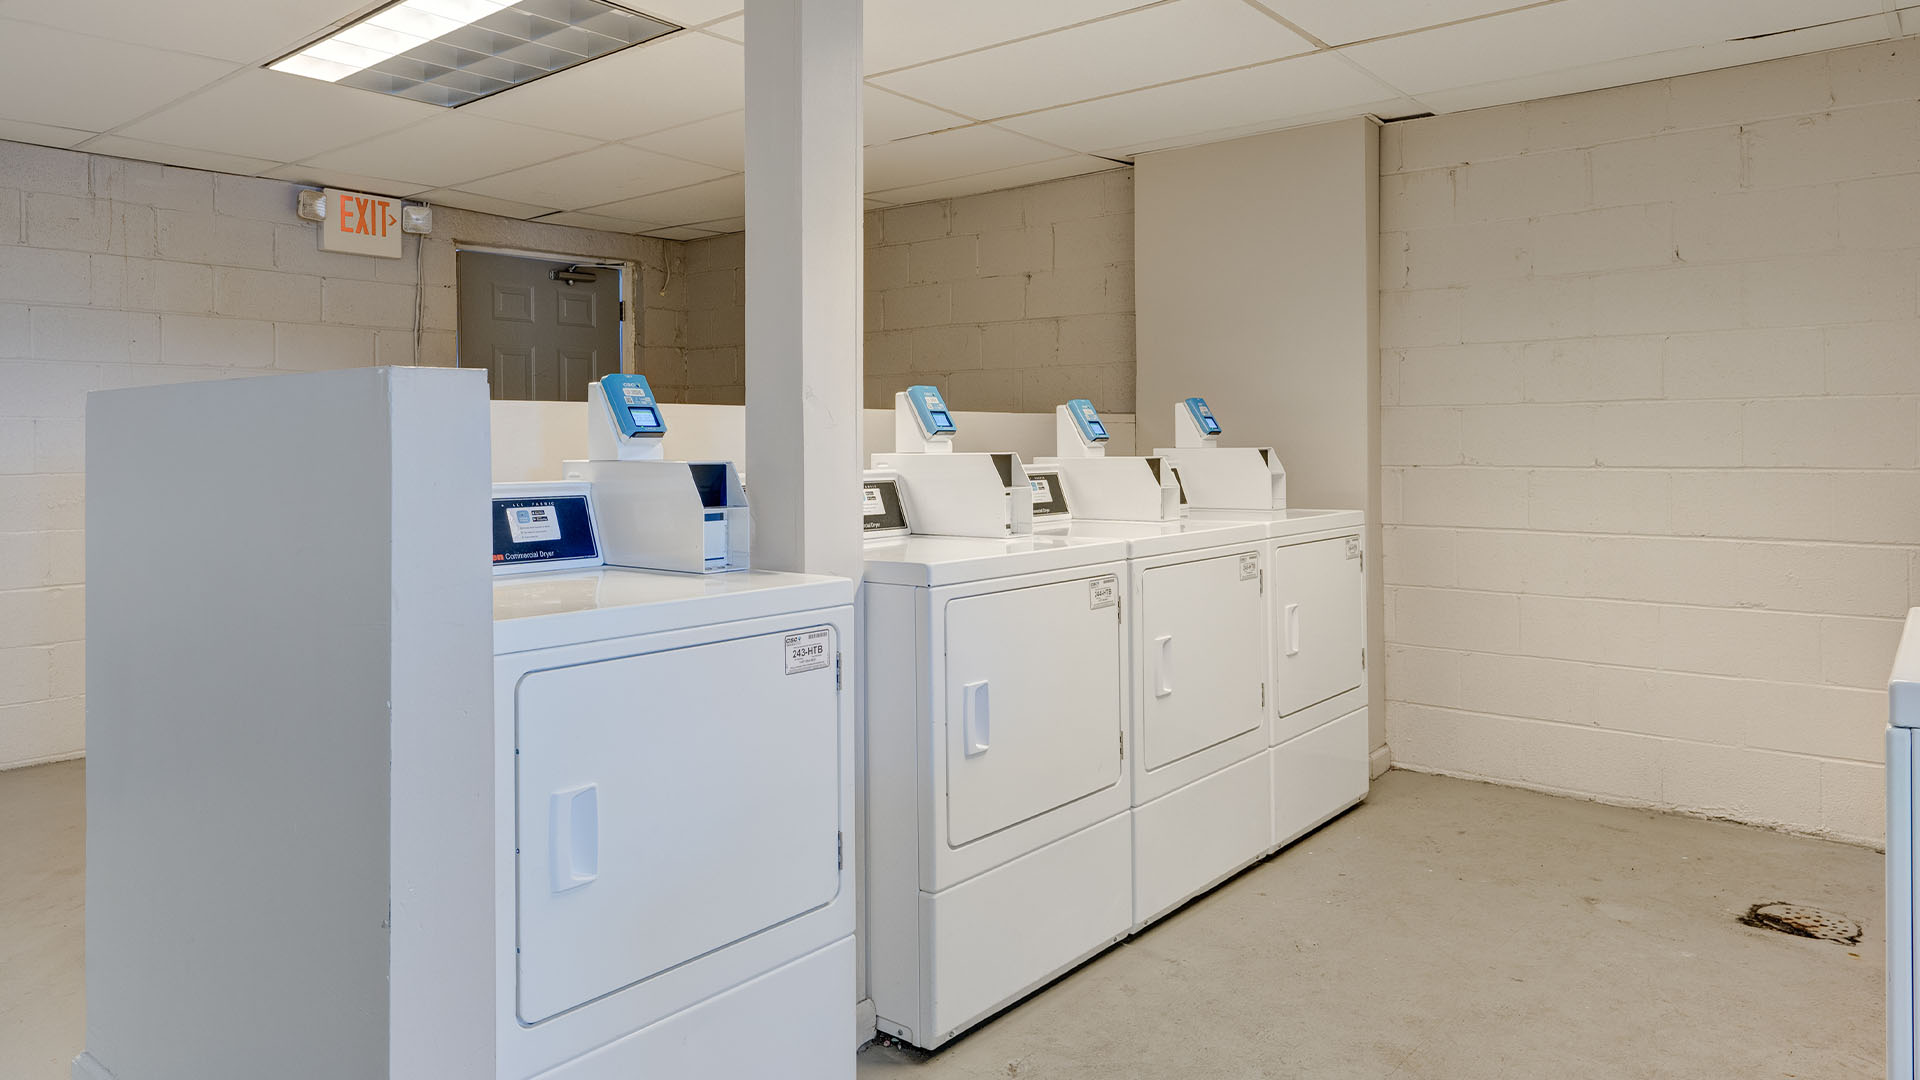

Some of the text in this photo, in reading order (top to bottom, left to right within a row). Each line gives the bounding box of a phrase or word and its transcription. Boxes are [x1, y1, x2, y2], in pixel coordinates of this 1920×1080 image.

[340, 195, 390, 237] EXIT
[505, 551, 539, 560] Commercial
[539, 550, 555, 559] Dryer
[792, 645, 823, 659] 243-HTB
